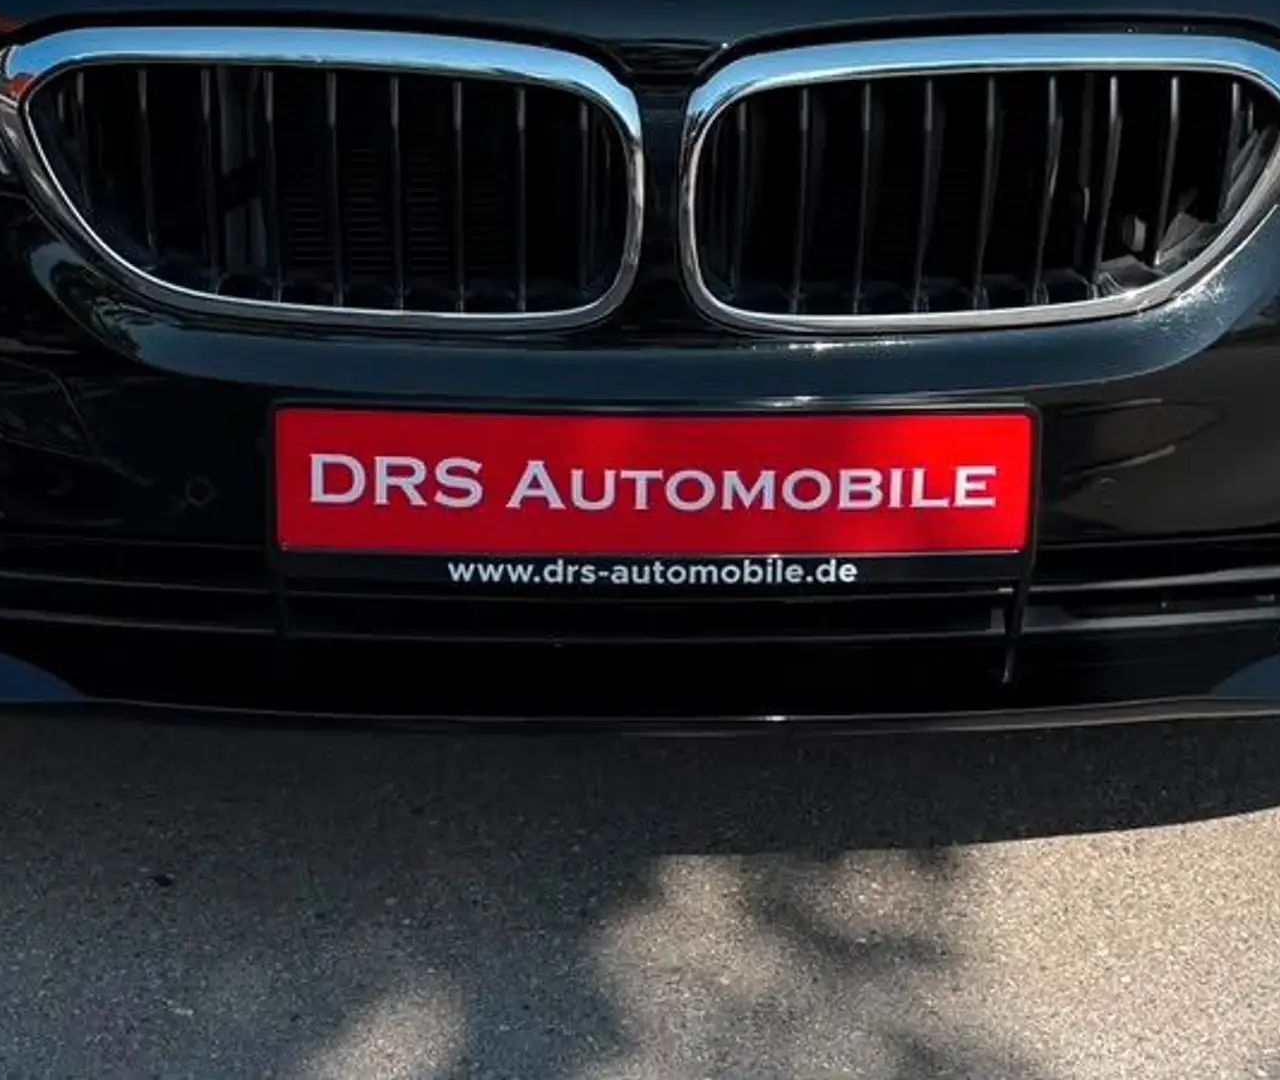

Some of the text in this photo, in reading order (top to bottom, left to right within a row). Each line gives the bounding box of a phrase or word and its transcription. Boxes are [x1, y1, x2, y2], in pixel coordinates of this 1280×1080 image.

[308, 452, 998, 512] DRS AUTOMOBILE
[447, 558, 859, 585] www.drs-automobile.de
